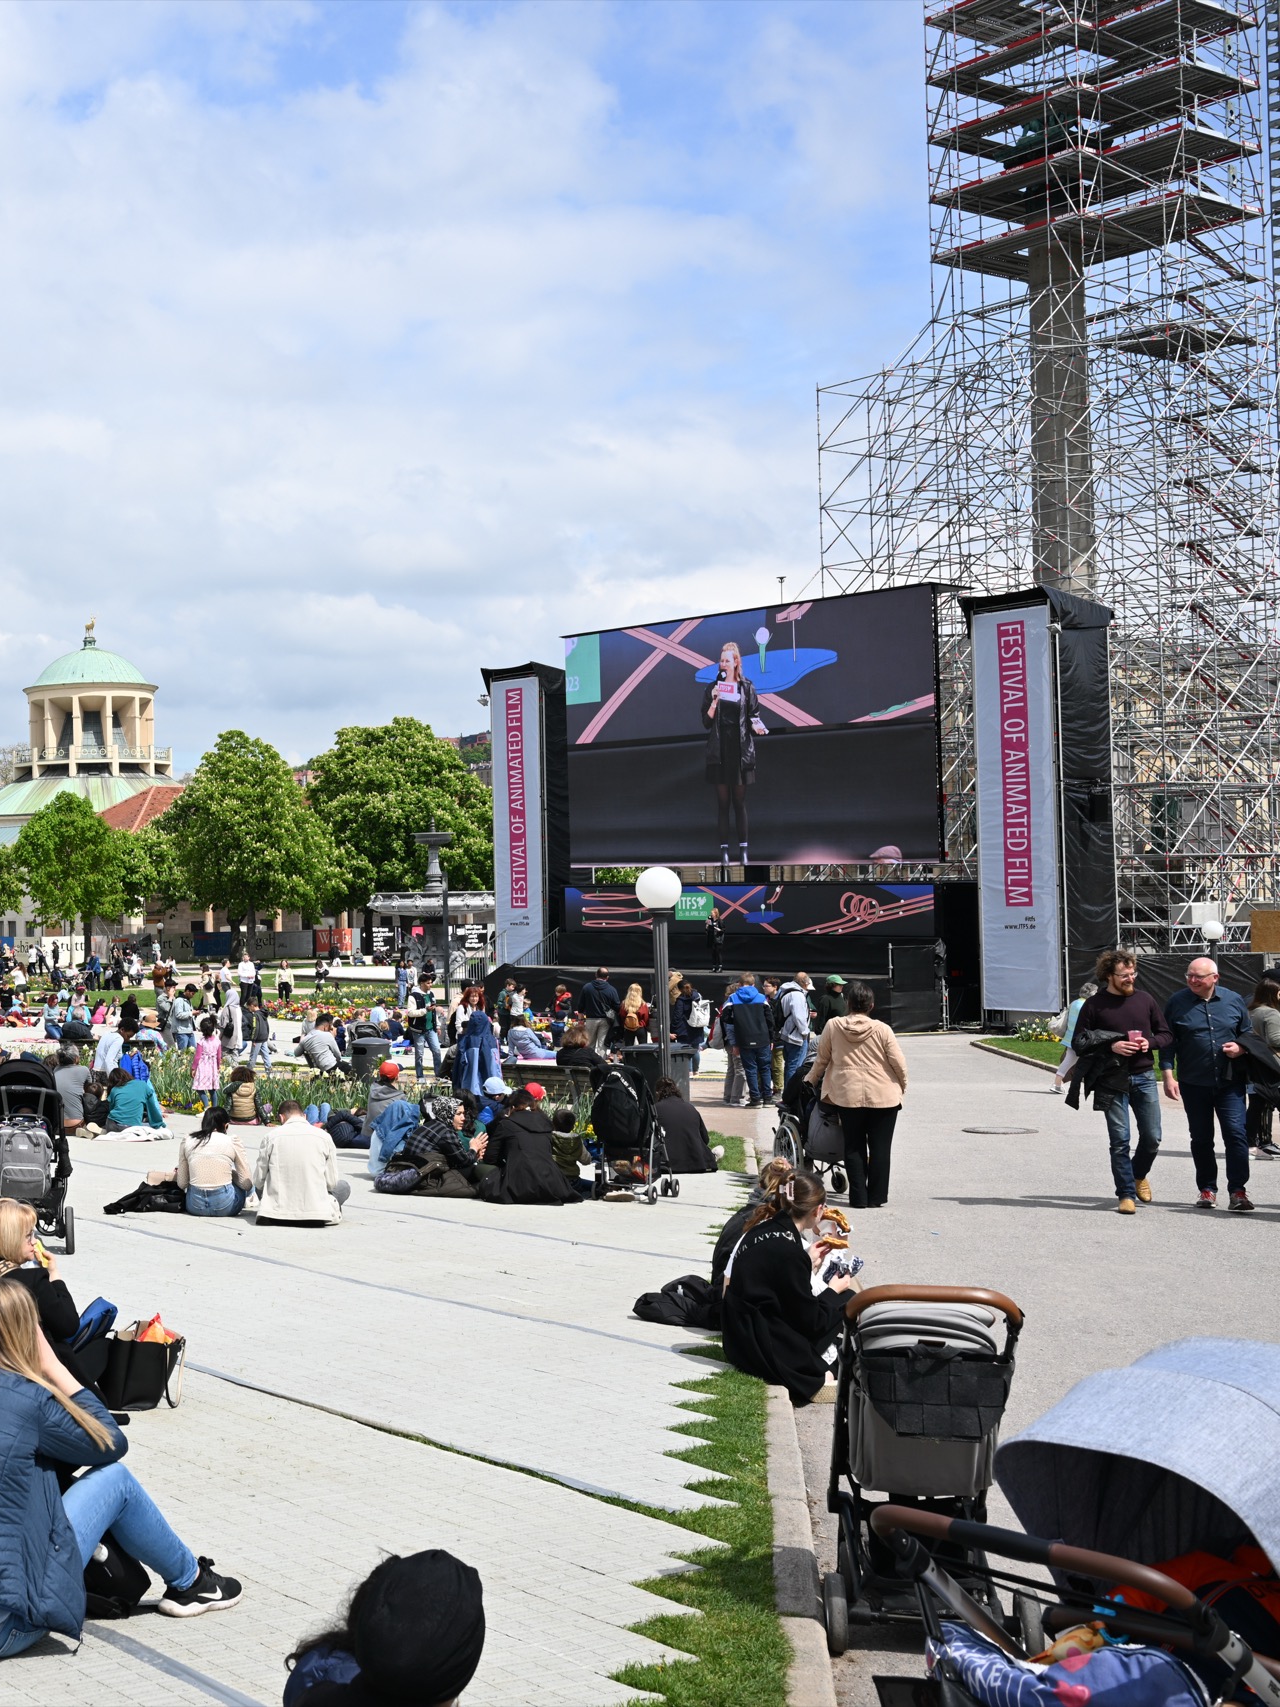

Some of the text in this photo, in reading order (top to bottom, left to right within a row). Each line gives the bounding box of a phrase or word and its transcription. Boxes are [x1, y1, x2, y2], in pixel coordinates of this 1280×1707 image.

[507, 690, 527, 906] FESTIVAL OF ANIMATED FILM
[1000, 624, 1030, 903] FESTIVAL OF ANIMATED FILM
[678, 896, 697, 910] ITFS
